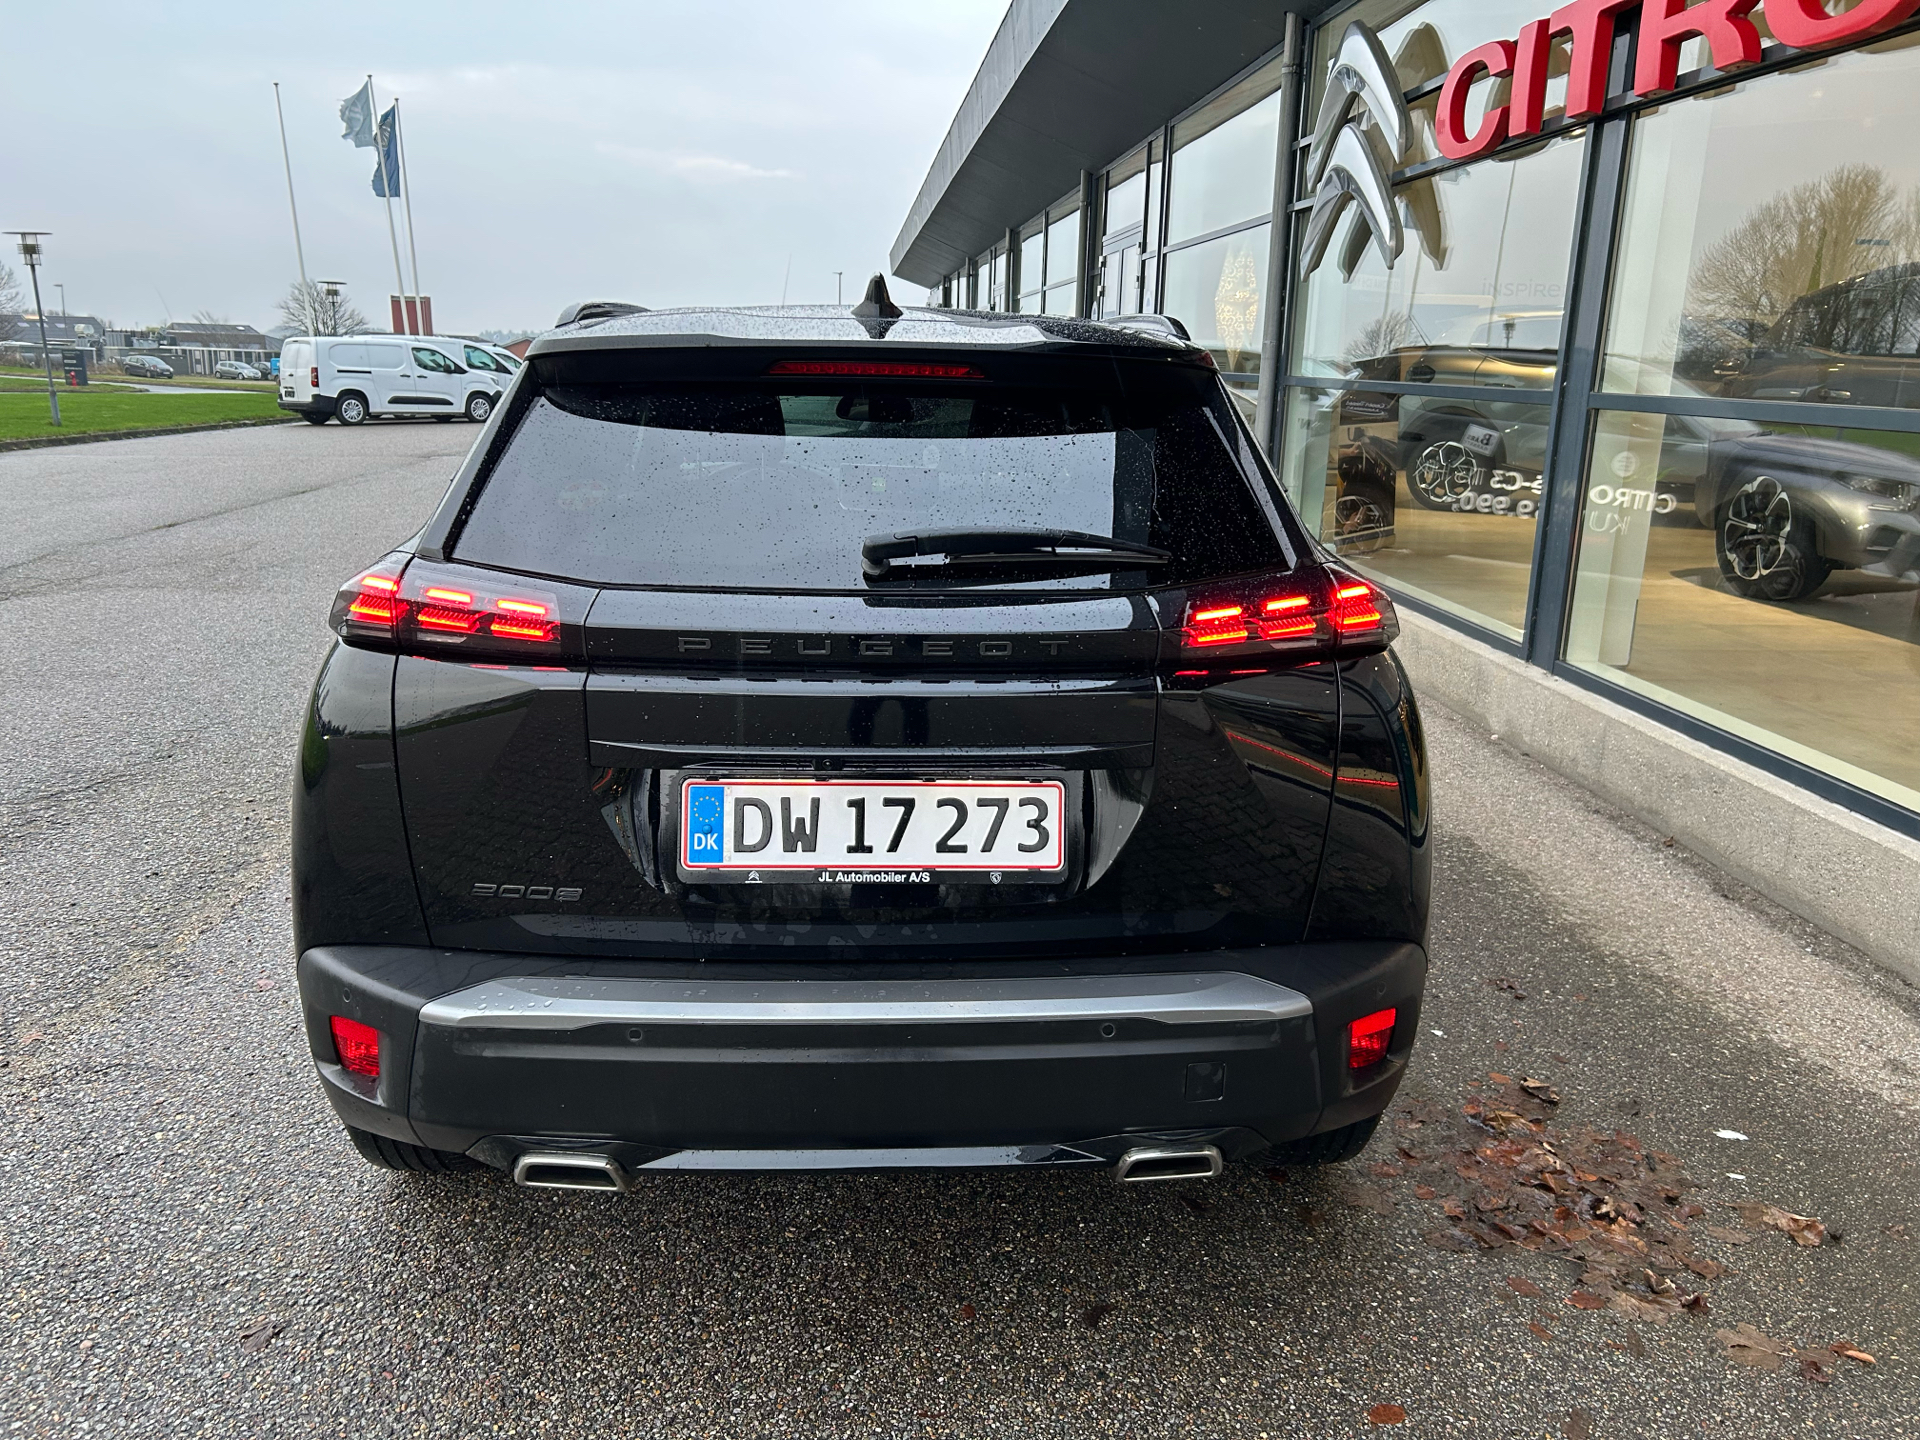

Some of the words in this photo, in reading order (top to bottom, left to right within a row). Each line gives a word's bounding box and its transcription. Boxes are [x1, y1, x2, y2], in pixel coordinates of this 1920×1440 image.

[677, 636, 1069, 657] PEUGEOT
[733, 796, 821, 853] DW
[846, 796, 916, 854] 17
[935, 796, 1050, 854] 273
[693, 832, 719, 851] DK
[818, 871, 833, 883] JL
[835, 871, 907, 883] Automobiler
[908, 871, 931, 883] A/S
[471, 882, 583, 902] 2008
